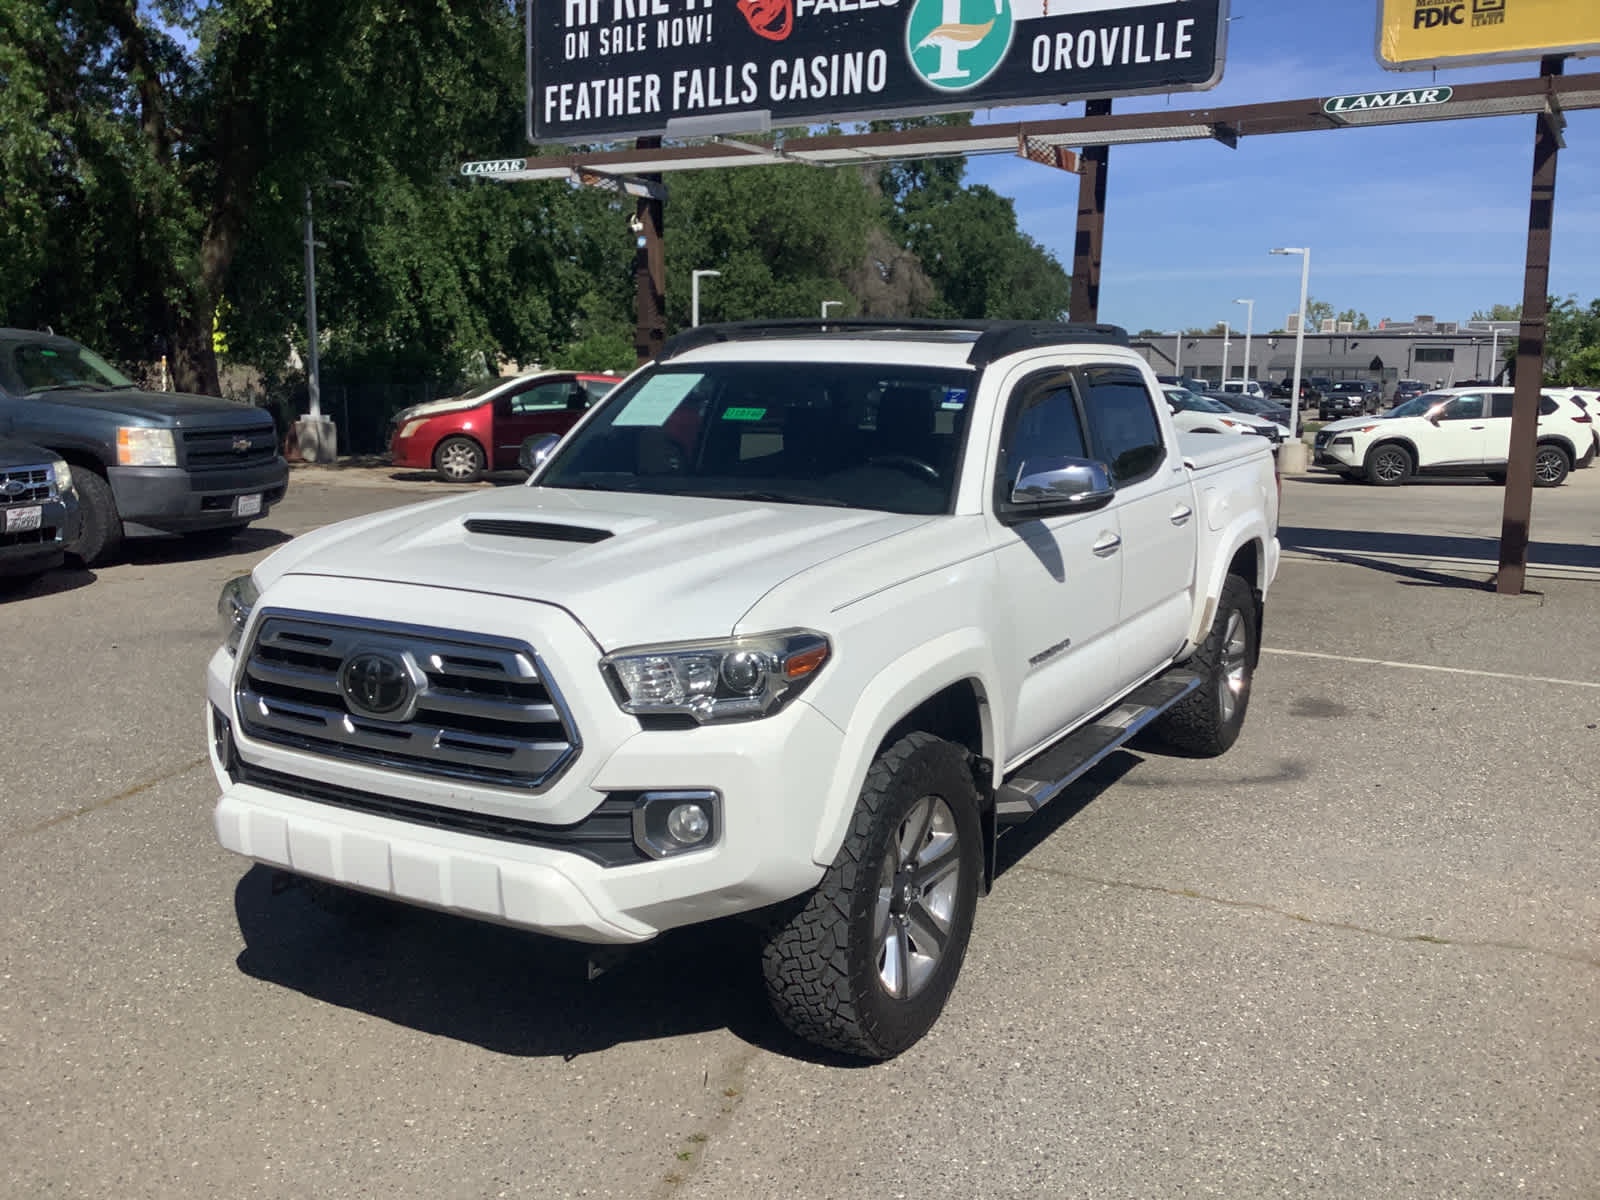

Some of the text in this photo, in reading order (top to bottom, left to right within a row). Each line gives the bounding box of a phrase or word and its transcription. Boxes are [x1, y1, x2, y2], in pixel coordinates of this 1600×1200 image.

[1413, 4, 1465, 29] FDIC
[565, 31, 589, 60] ON
[600, 23, 647, 55] SALE
[657, 13, 712, 48] NOW!
[1032, 19, 1195, 73] OROVILLE
[545, 49, 887, 123] FEATHER FALLS CASINO
[1334, 89, 1439, 110] LAMAR
[467, 161, 521, 174] LAMAR
